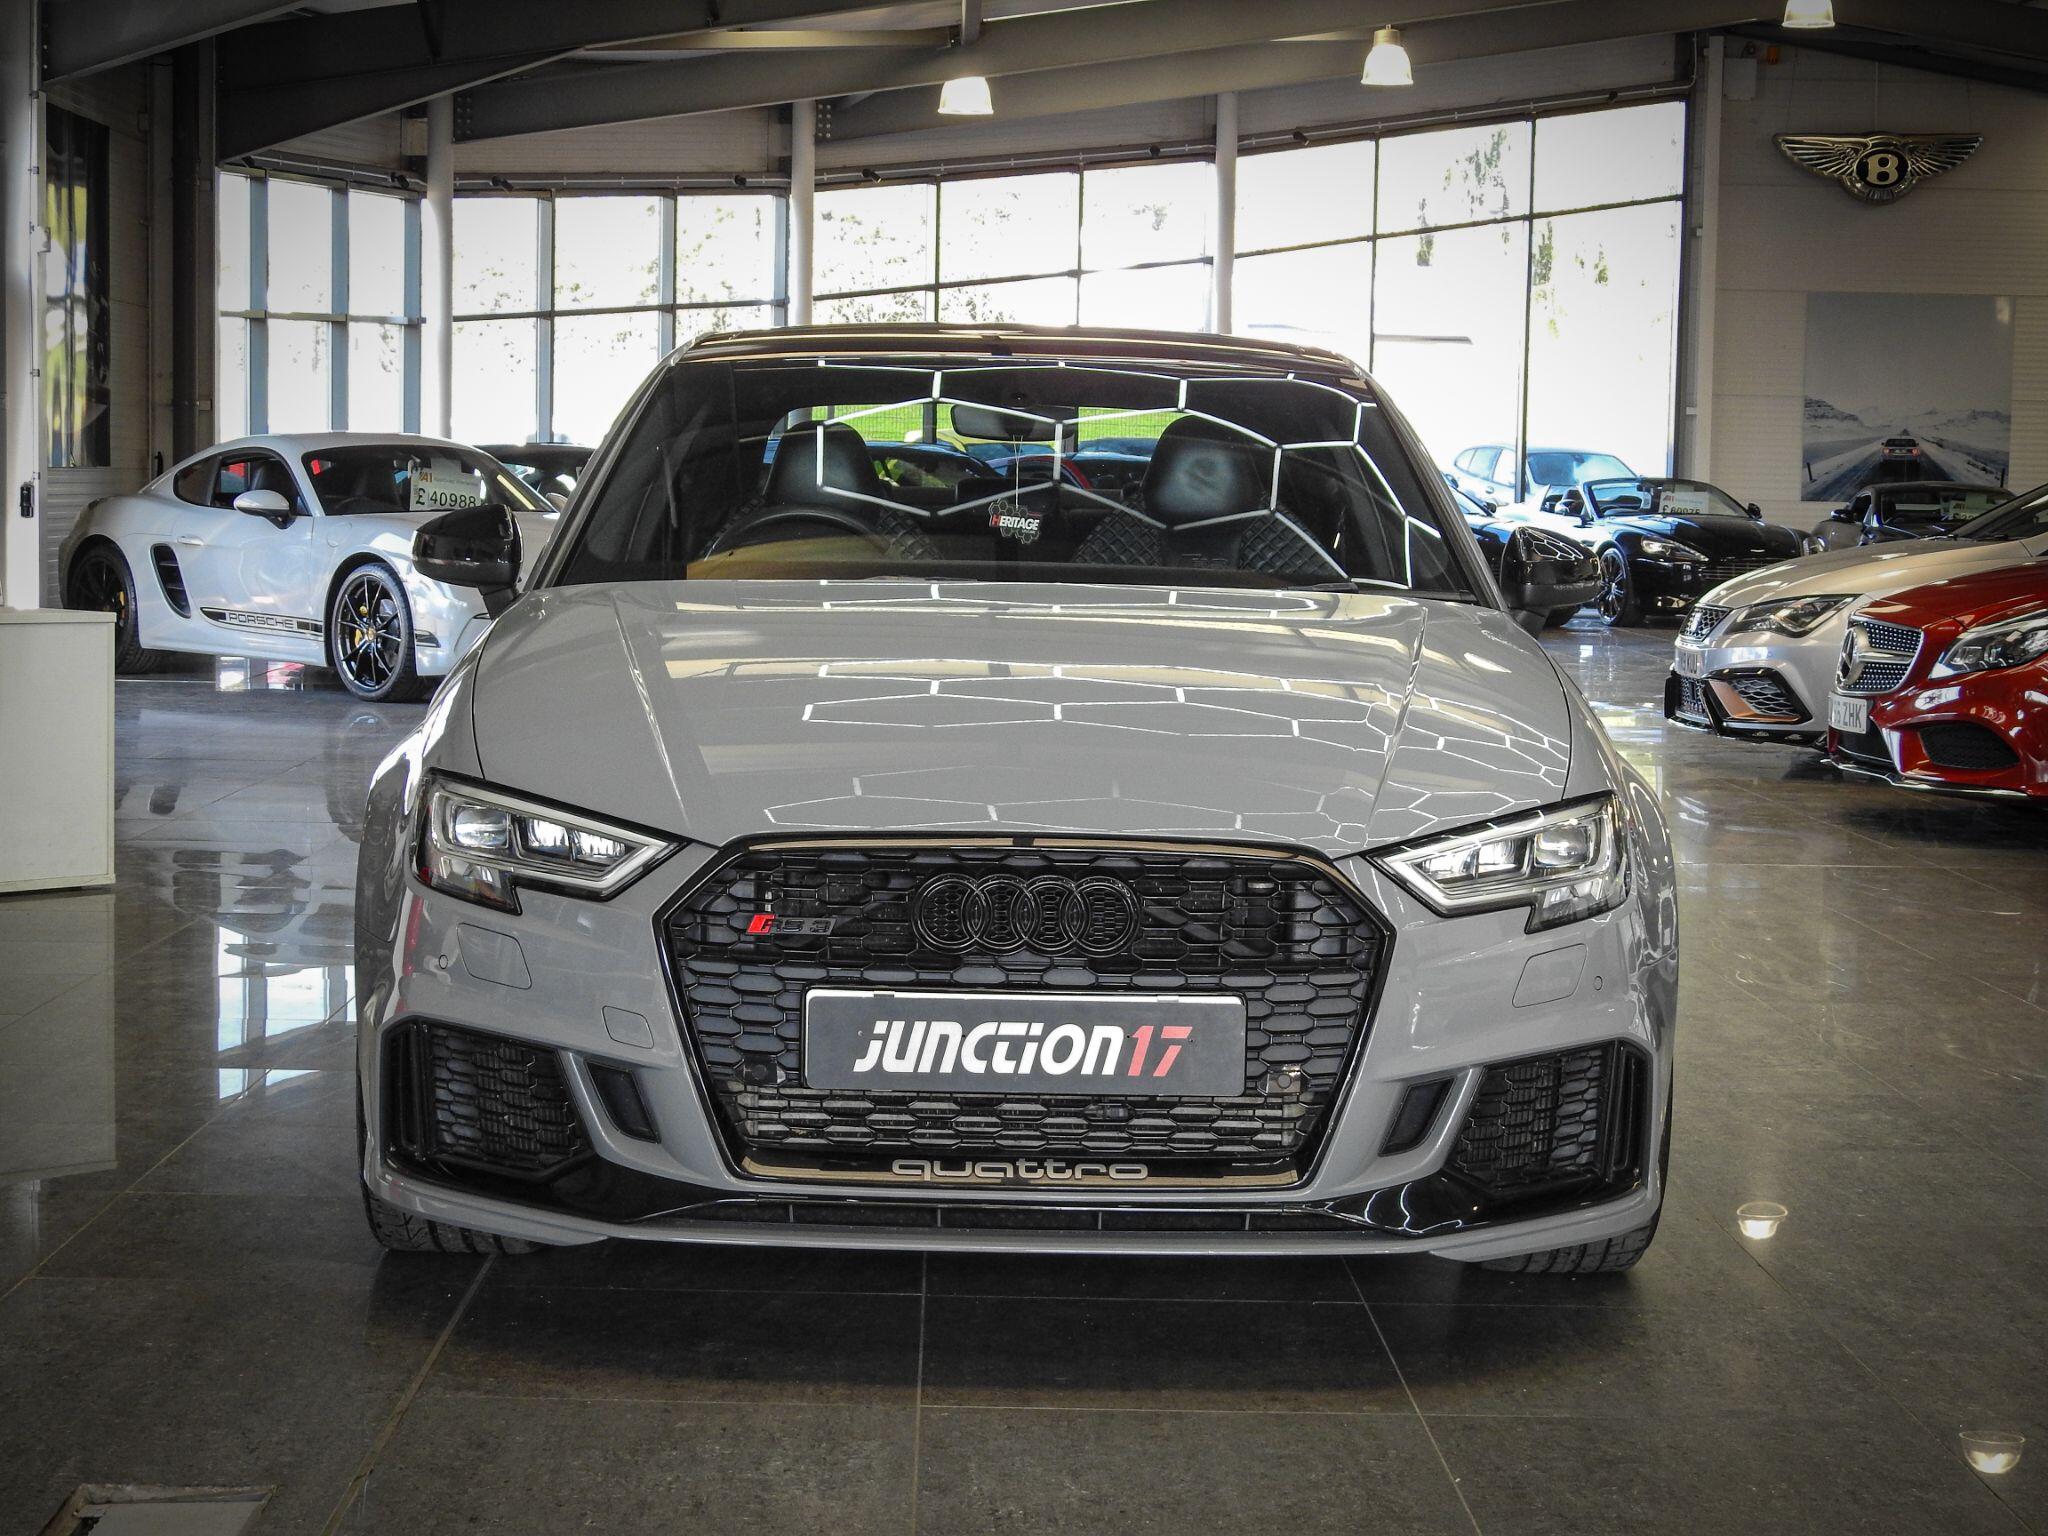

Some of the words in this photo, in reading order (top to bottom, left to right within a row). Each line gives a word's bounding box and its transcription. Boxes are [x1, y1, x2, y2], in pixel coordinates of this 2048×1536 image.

[1866, 153, 1899, 185] B
[991, 513, 1040, 531] HERITAGE
[228, 612, 295, 630] PORSCHE
[891, 1158, 1149, 1181] quattro
